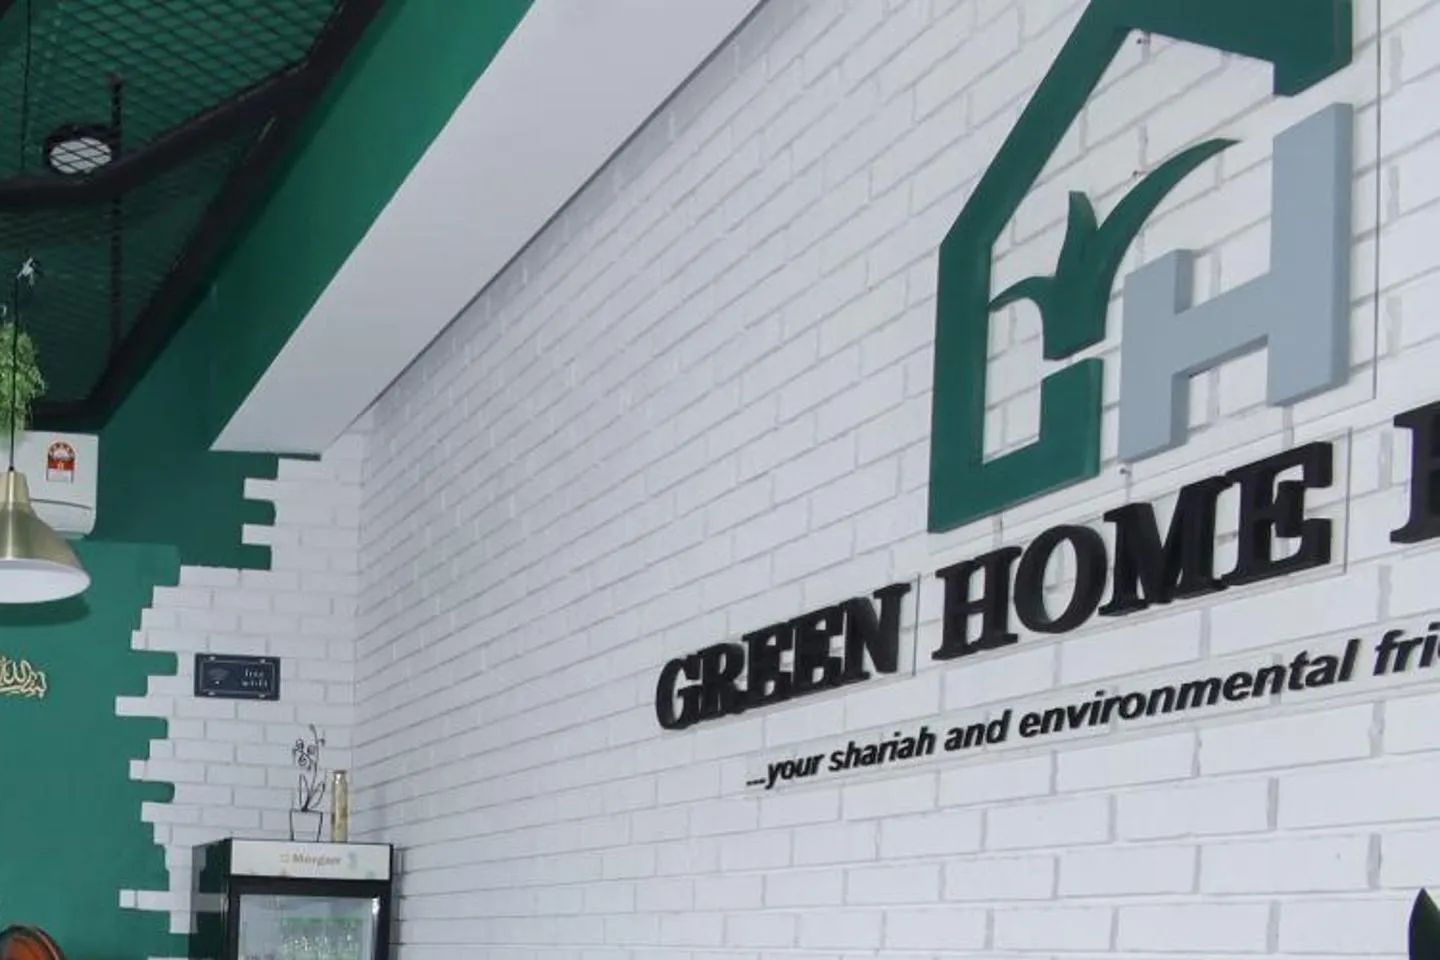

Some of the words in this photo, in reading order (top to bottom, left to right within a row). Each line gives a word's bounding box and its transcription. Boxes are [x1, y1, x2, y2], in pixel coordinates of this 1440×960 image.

[656, 583, 912, 730] GREEN
[931, 441, 1333, 660] HOME
[828, 726, 936, 772] shariah
[944, 709, 1012, 751] and
[1019, 638, 1361, 739] environmental
[1373, 621, 1440, 676] fri
